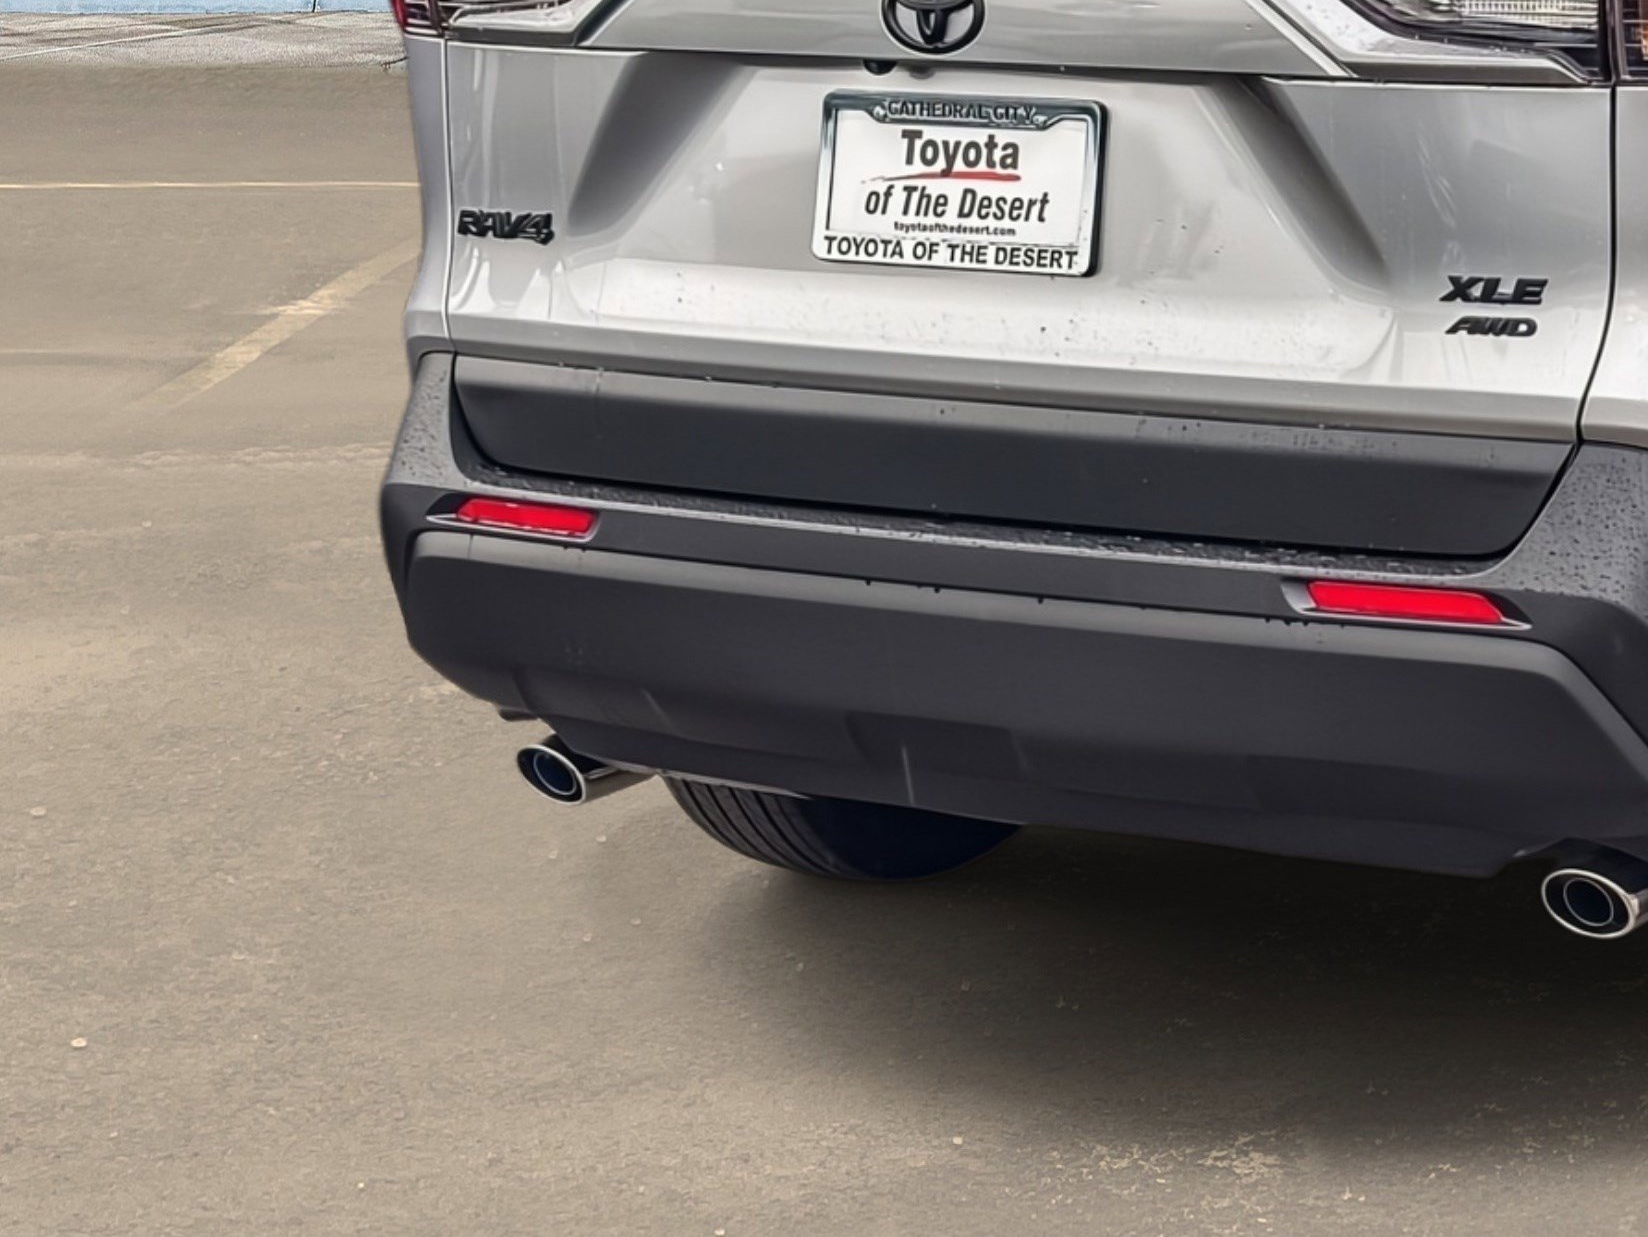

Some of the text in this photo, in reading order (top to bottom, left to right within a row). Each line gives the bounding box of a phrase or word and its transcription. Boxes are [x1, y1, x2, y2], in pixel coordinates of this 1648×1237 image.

[888, 100, 1035, 123] CATHEDRAL CITY
[900, 128, 1021, 178] Toyota
[864, 184, 1051, 223] of The Desert
[457, 209, 555, 245] RAV4
[893, 221, 1017, 237] toyotaofthedesert.com
[823, 235, 1079, 270] TOYOTA OF THE DESERT
[1438, 274, 1549, 306] XLE
[1444, 315, 1538, 338] AWD
